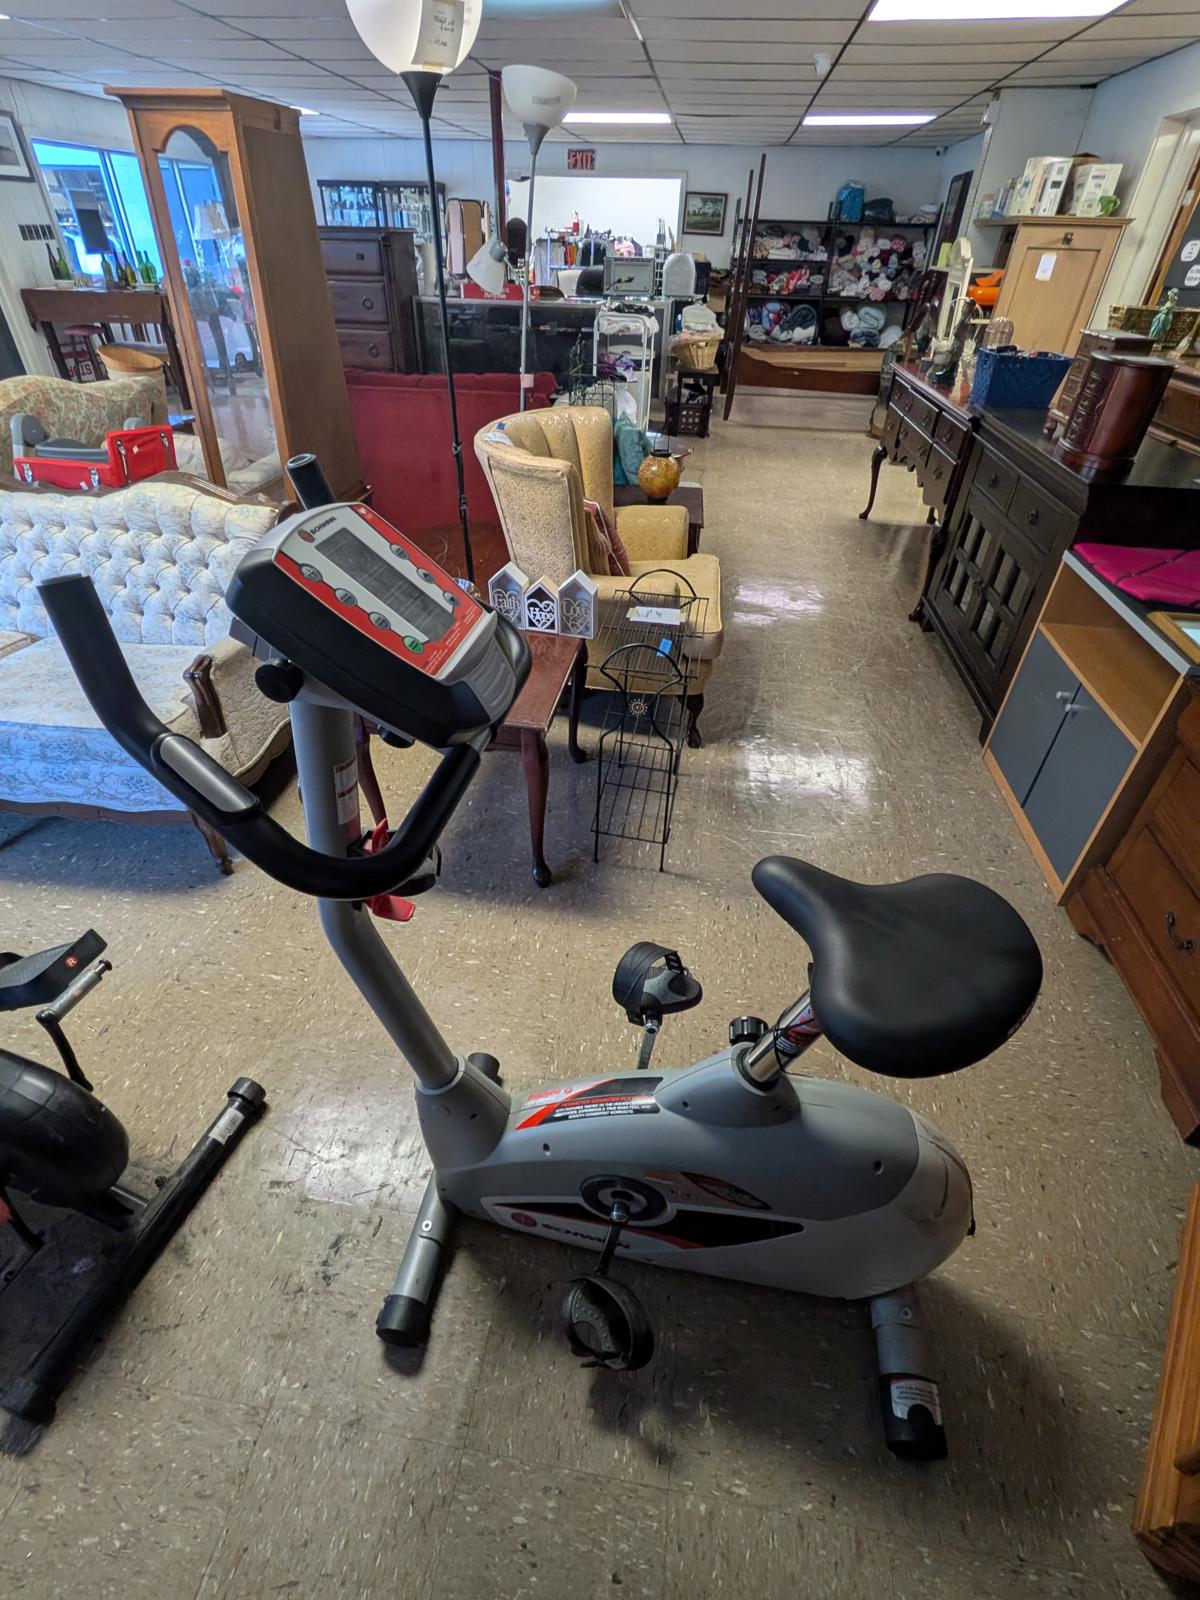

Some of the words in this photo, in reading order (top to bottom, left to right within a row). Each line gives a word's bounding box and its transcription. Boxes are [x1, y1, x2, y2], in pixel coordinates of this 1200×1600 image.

[568, 151, 593, 170] EXIT
[494, 593, 520, 610] Faith
[562, 599, 590, 617] Love
[529, 607, 554, 621] Hope
